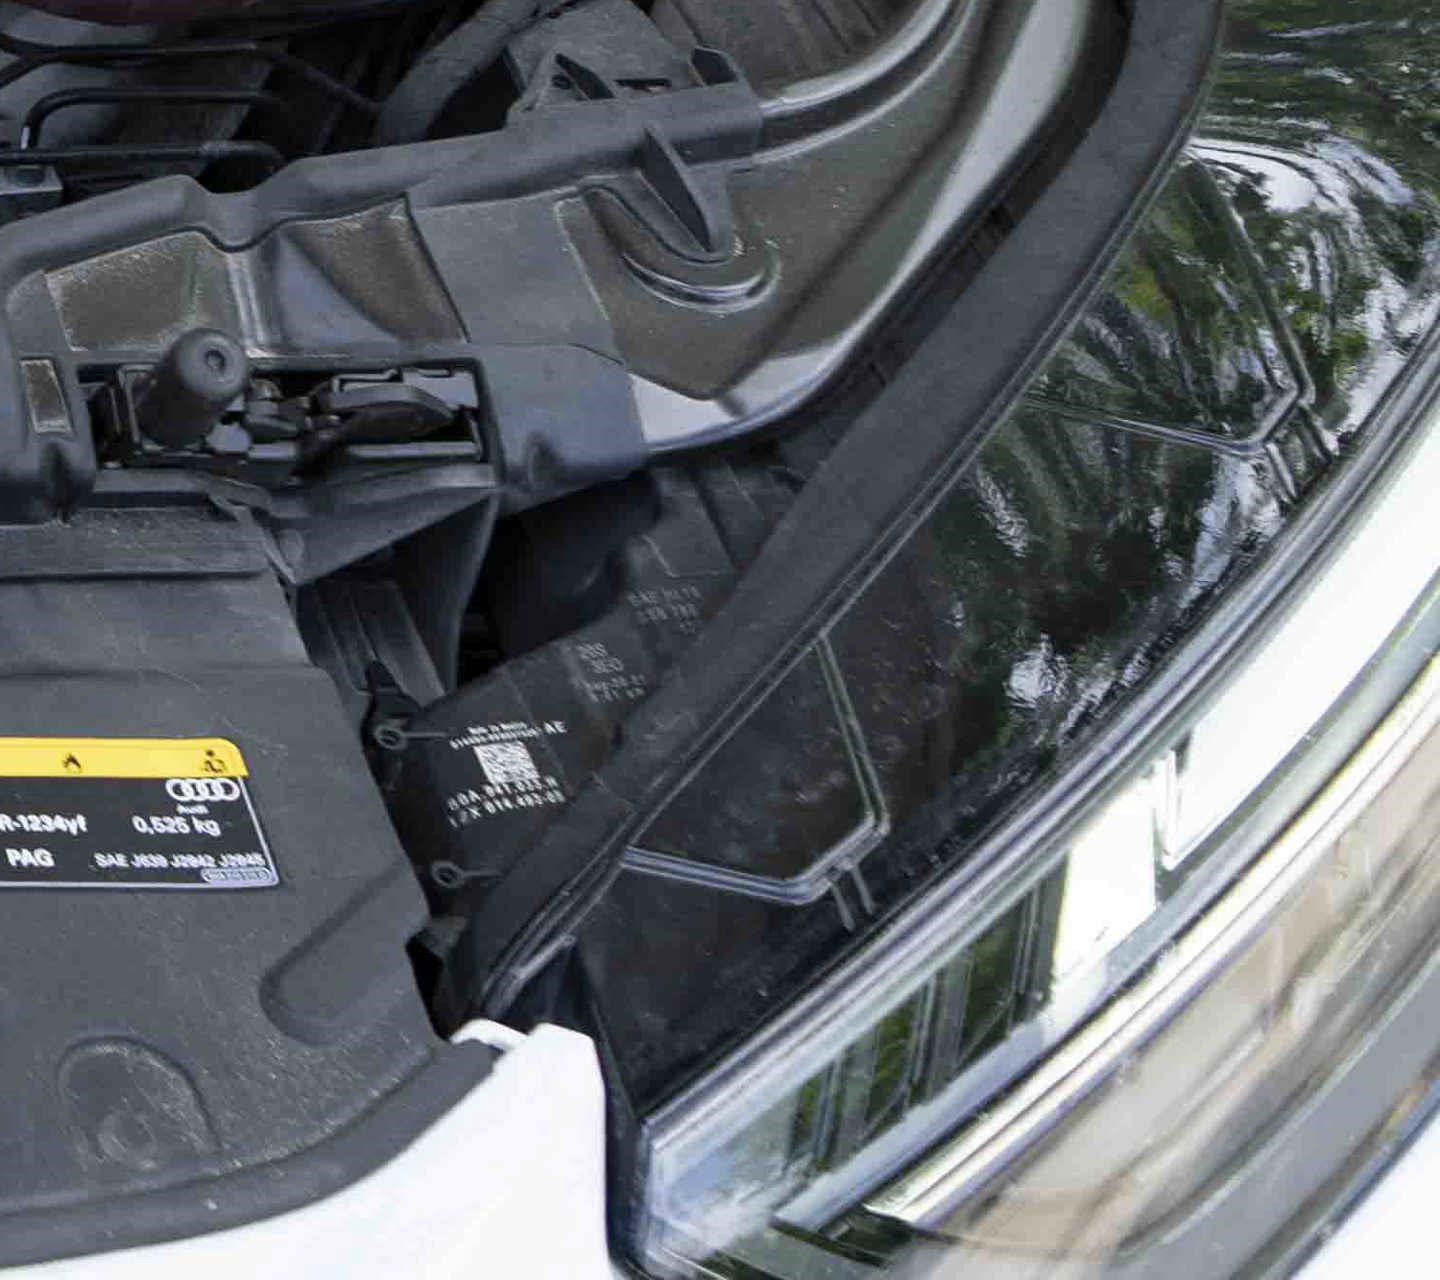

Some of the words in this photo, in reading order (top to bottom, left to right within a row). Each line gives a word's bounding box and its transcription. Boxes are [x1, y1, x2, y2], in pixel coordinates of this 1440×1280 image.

[132, 816, 191, 835] 0,525
[195, 816, 221, 836] kg
[5, 848, 56, 868] PAG
[94, 853, 128, 868] SAE
